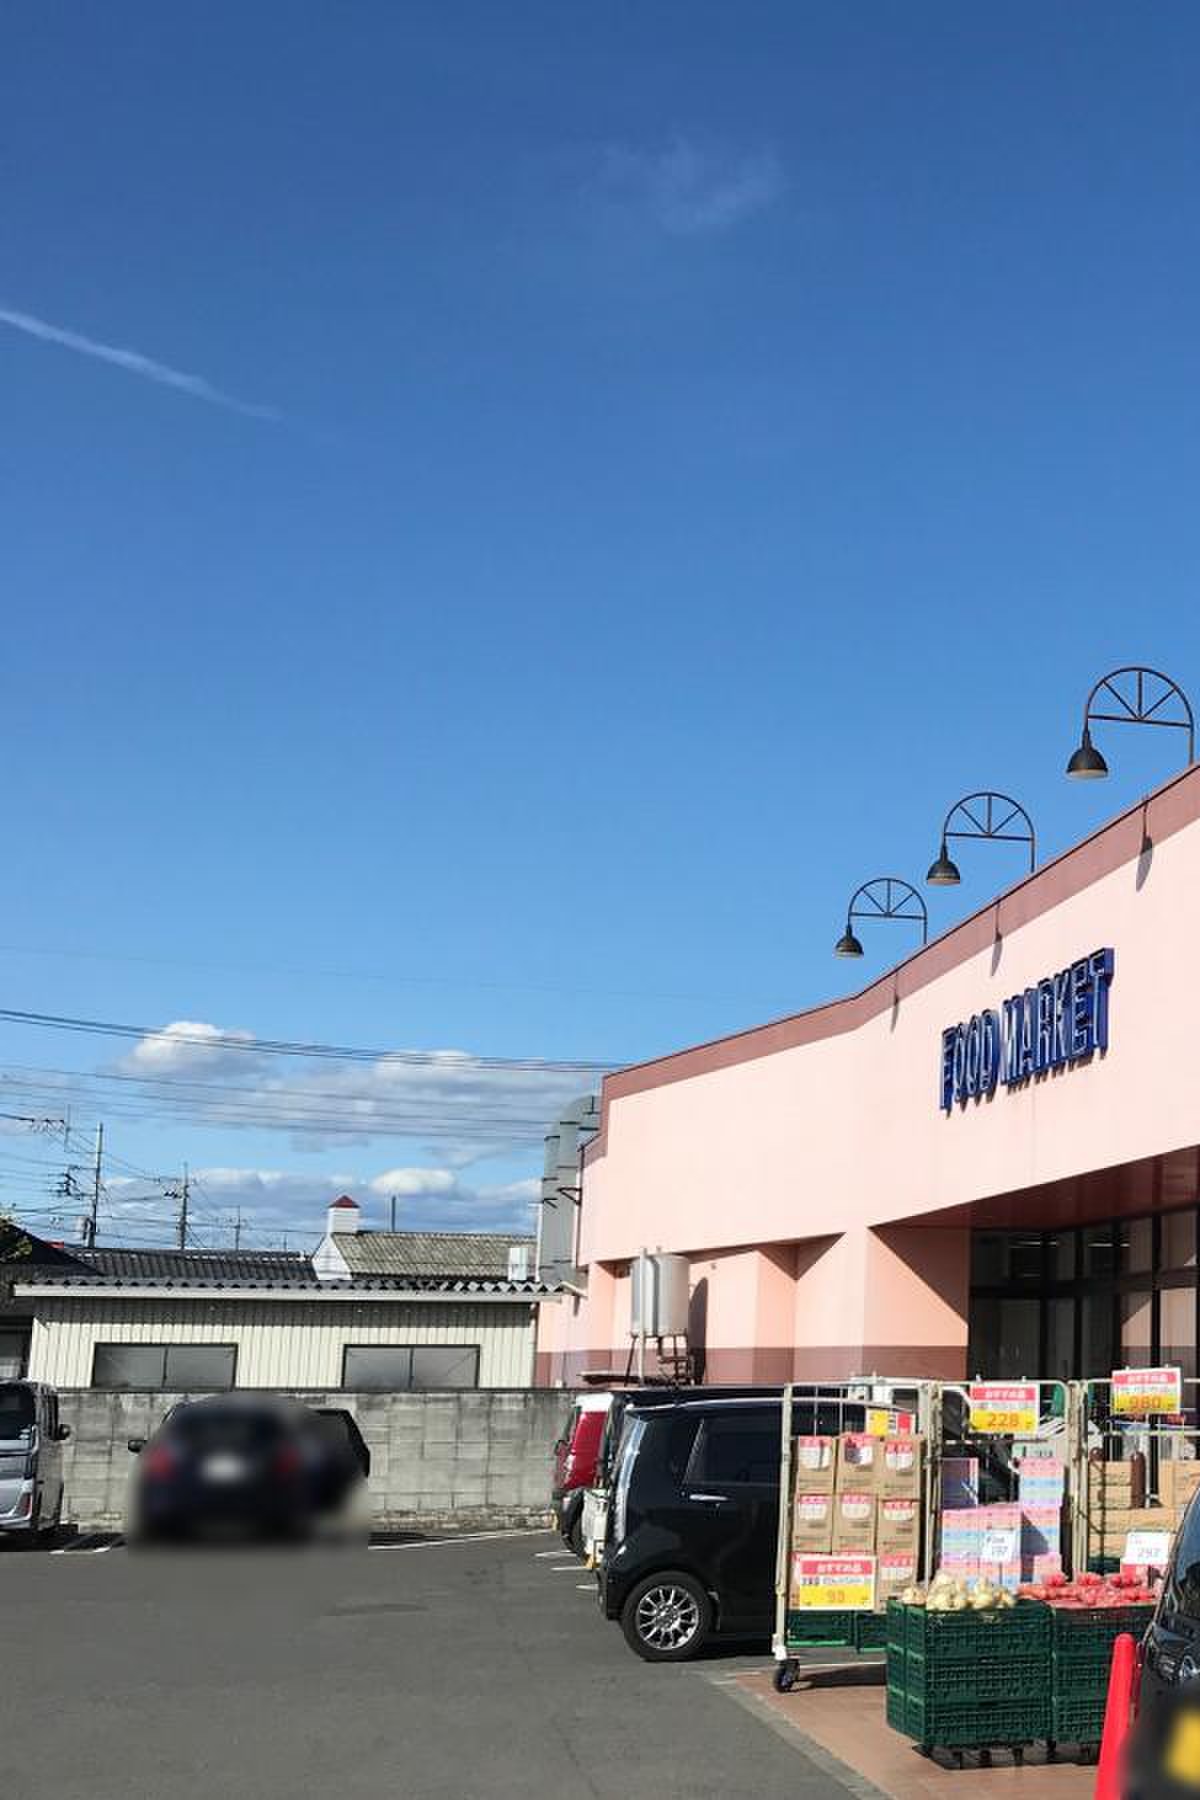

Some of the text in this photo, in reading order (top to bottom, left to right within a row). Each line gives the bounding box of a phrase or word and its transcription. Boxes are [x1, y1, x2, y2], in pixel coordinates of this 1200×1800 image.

[939, 947, 1115, 1110] FOOD MARKET
[987, 1412, 1020, 1428] 228
